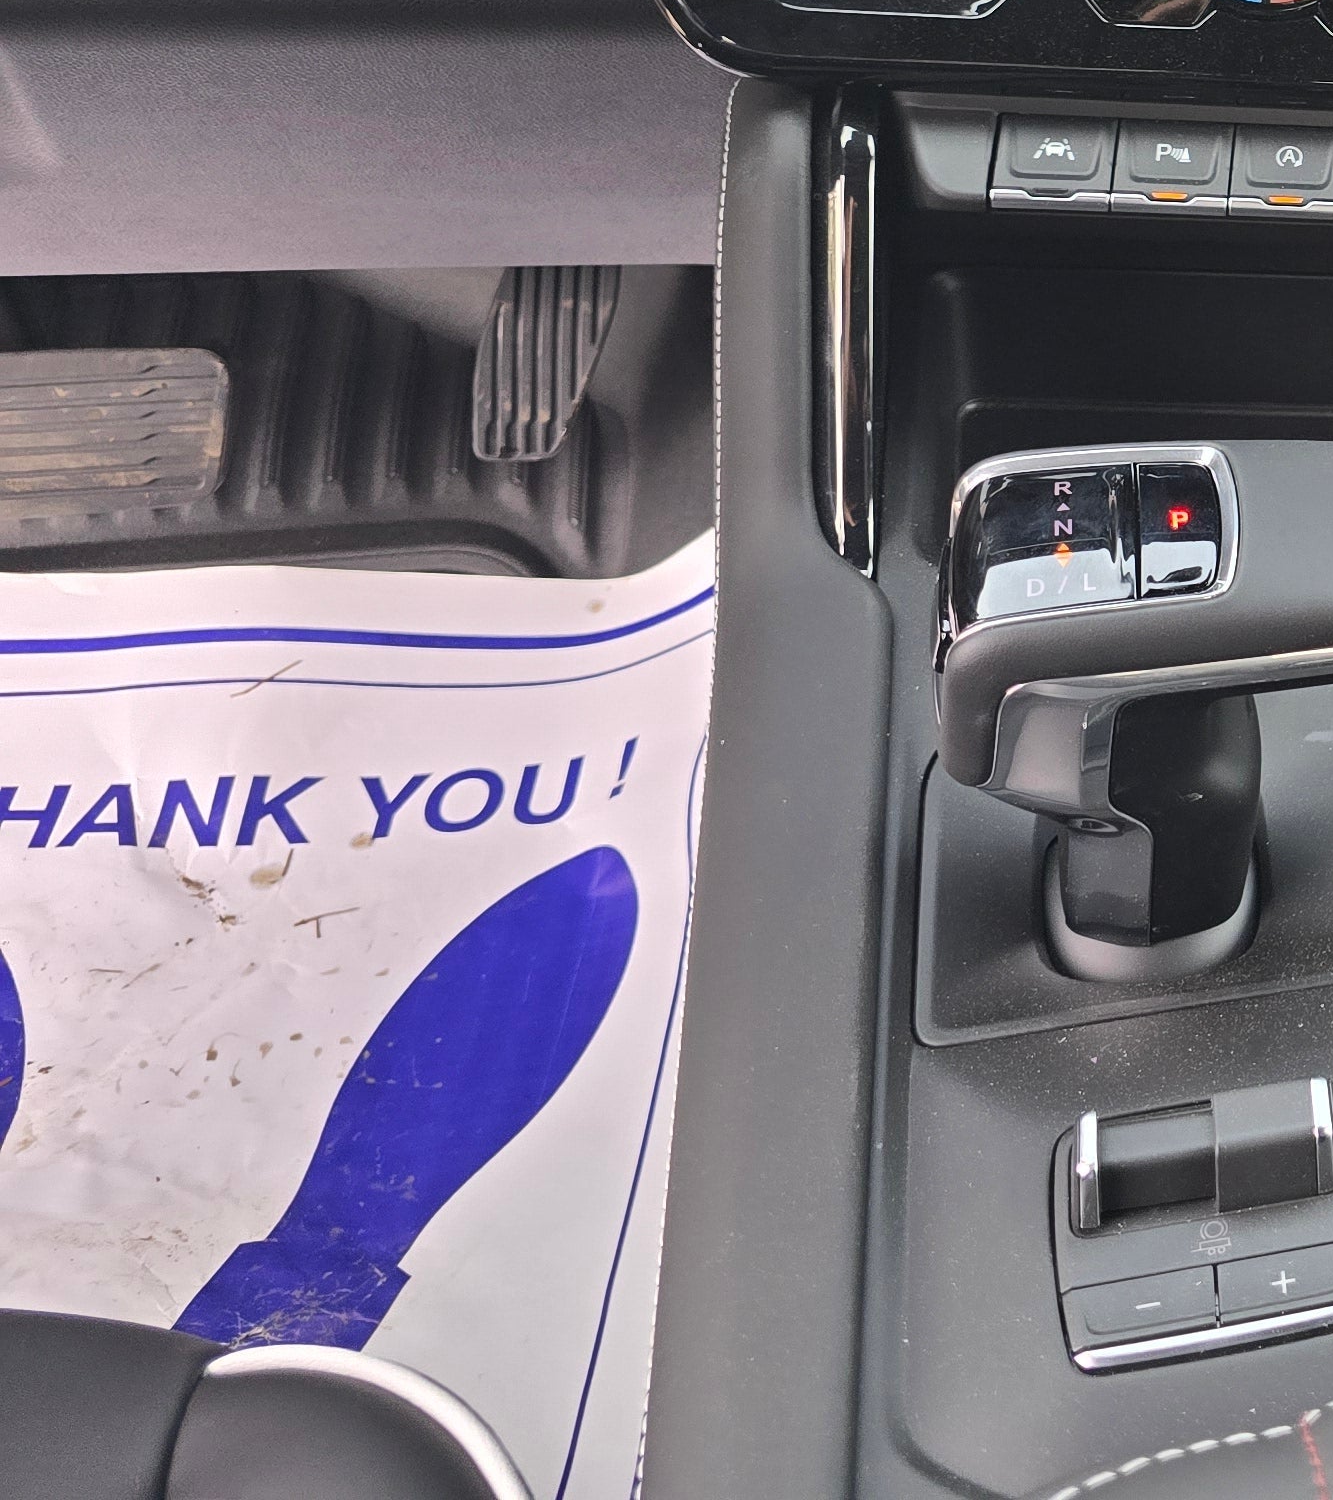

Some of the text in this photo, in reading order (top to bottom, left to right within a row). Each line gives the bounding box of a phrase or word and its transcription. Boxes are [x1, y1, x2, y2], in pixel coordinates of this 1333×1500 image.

[1155, 143, 1172, 161] P
[1282, 149, 1296, 163] A
[1054, 481, 1072, 496] R
[1054, 518, 1072, 537] N
[1170, 509, 1188, 530] P
